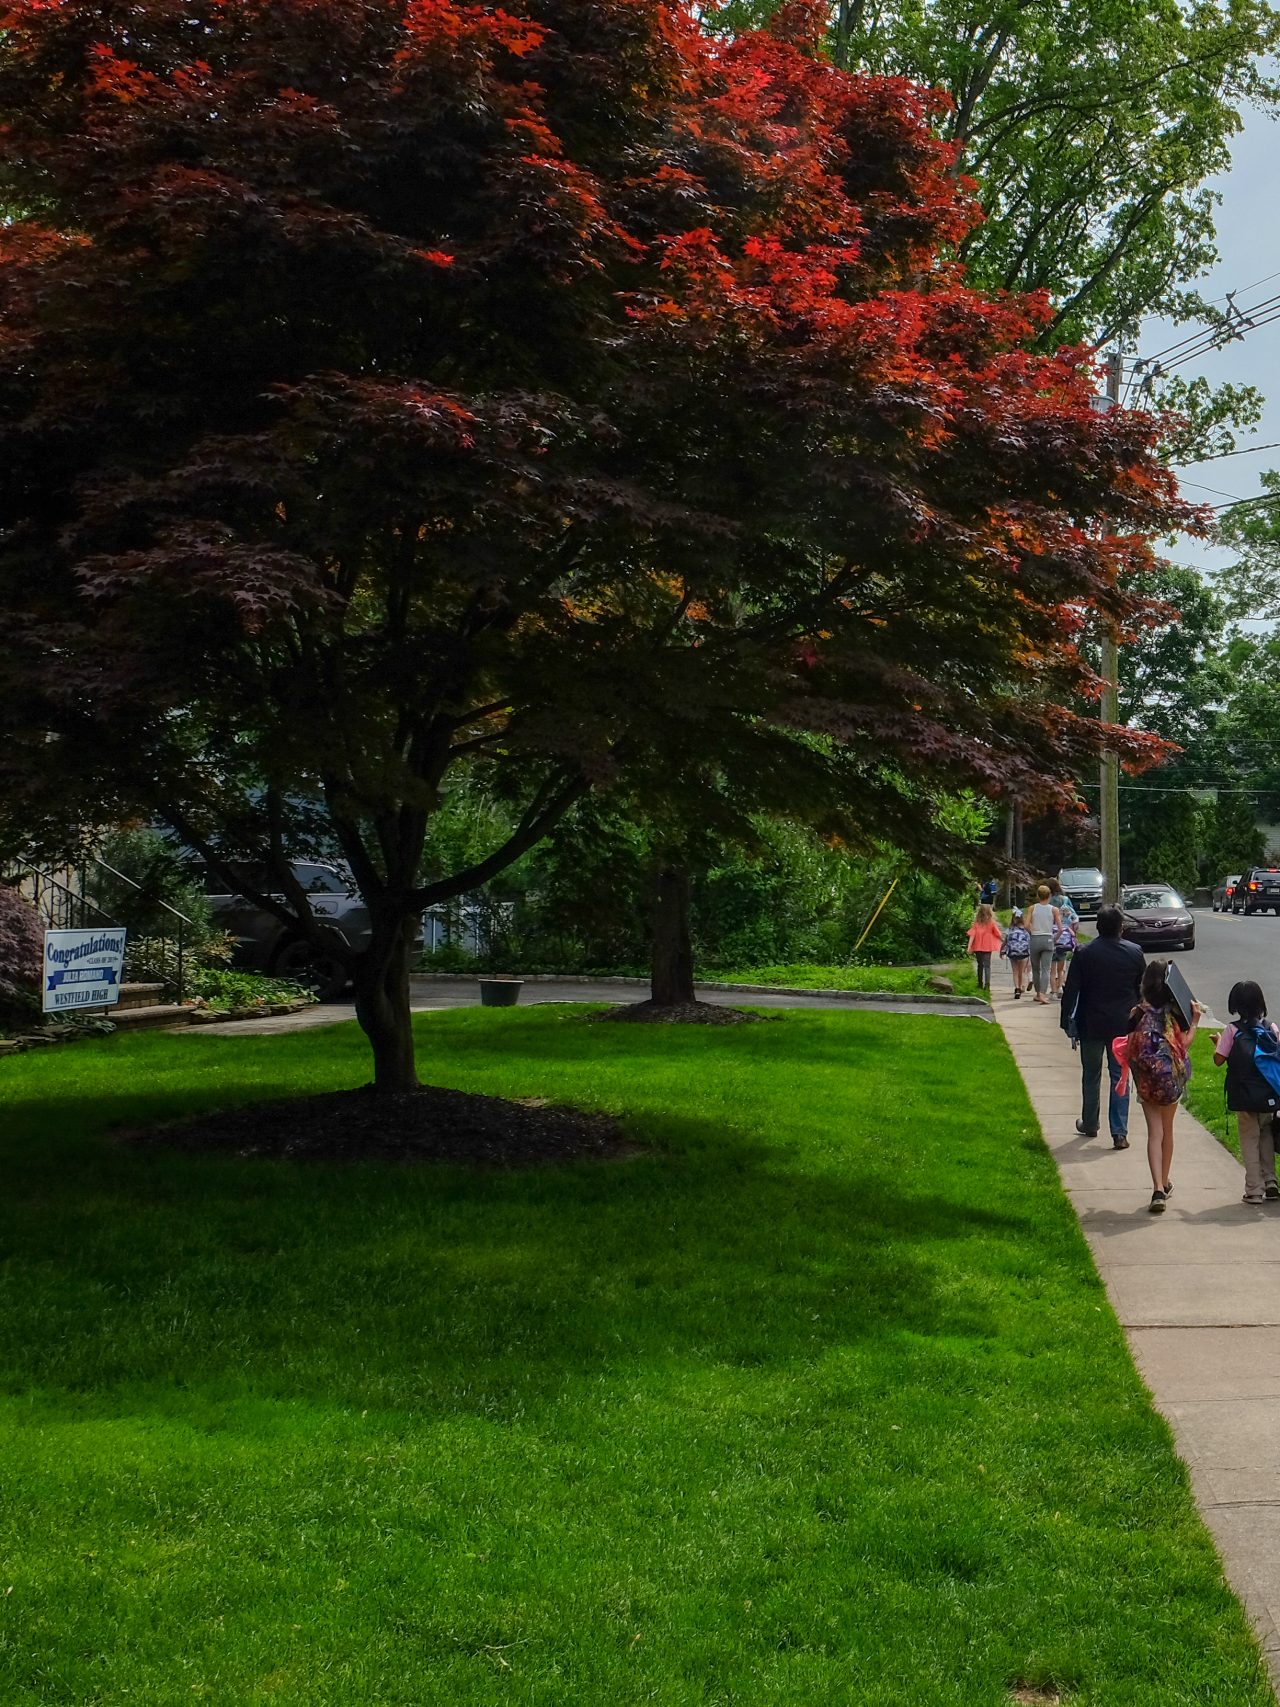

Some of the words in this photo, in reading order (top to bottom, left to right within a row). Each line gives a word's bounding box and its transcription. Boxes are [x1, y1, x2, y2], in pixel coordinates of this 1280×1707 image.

[47, 933, 123, 968] Congratulations!
[55, 991, 91, 1005] WESTFIELD
[92, 989, 108, 1000] HIGH
